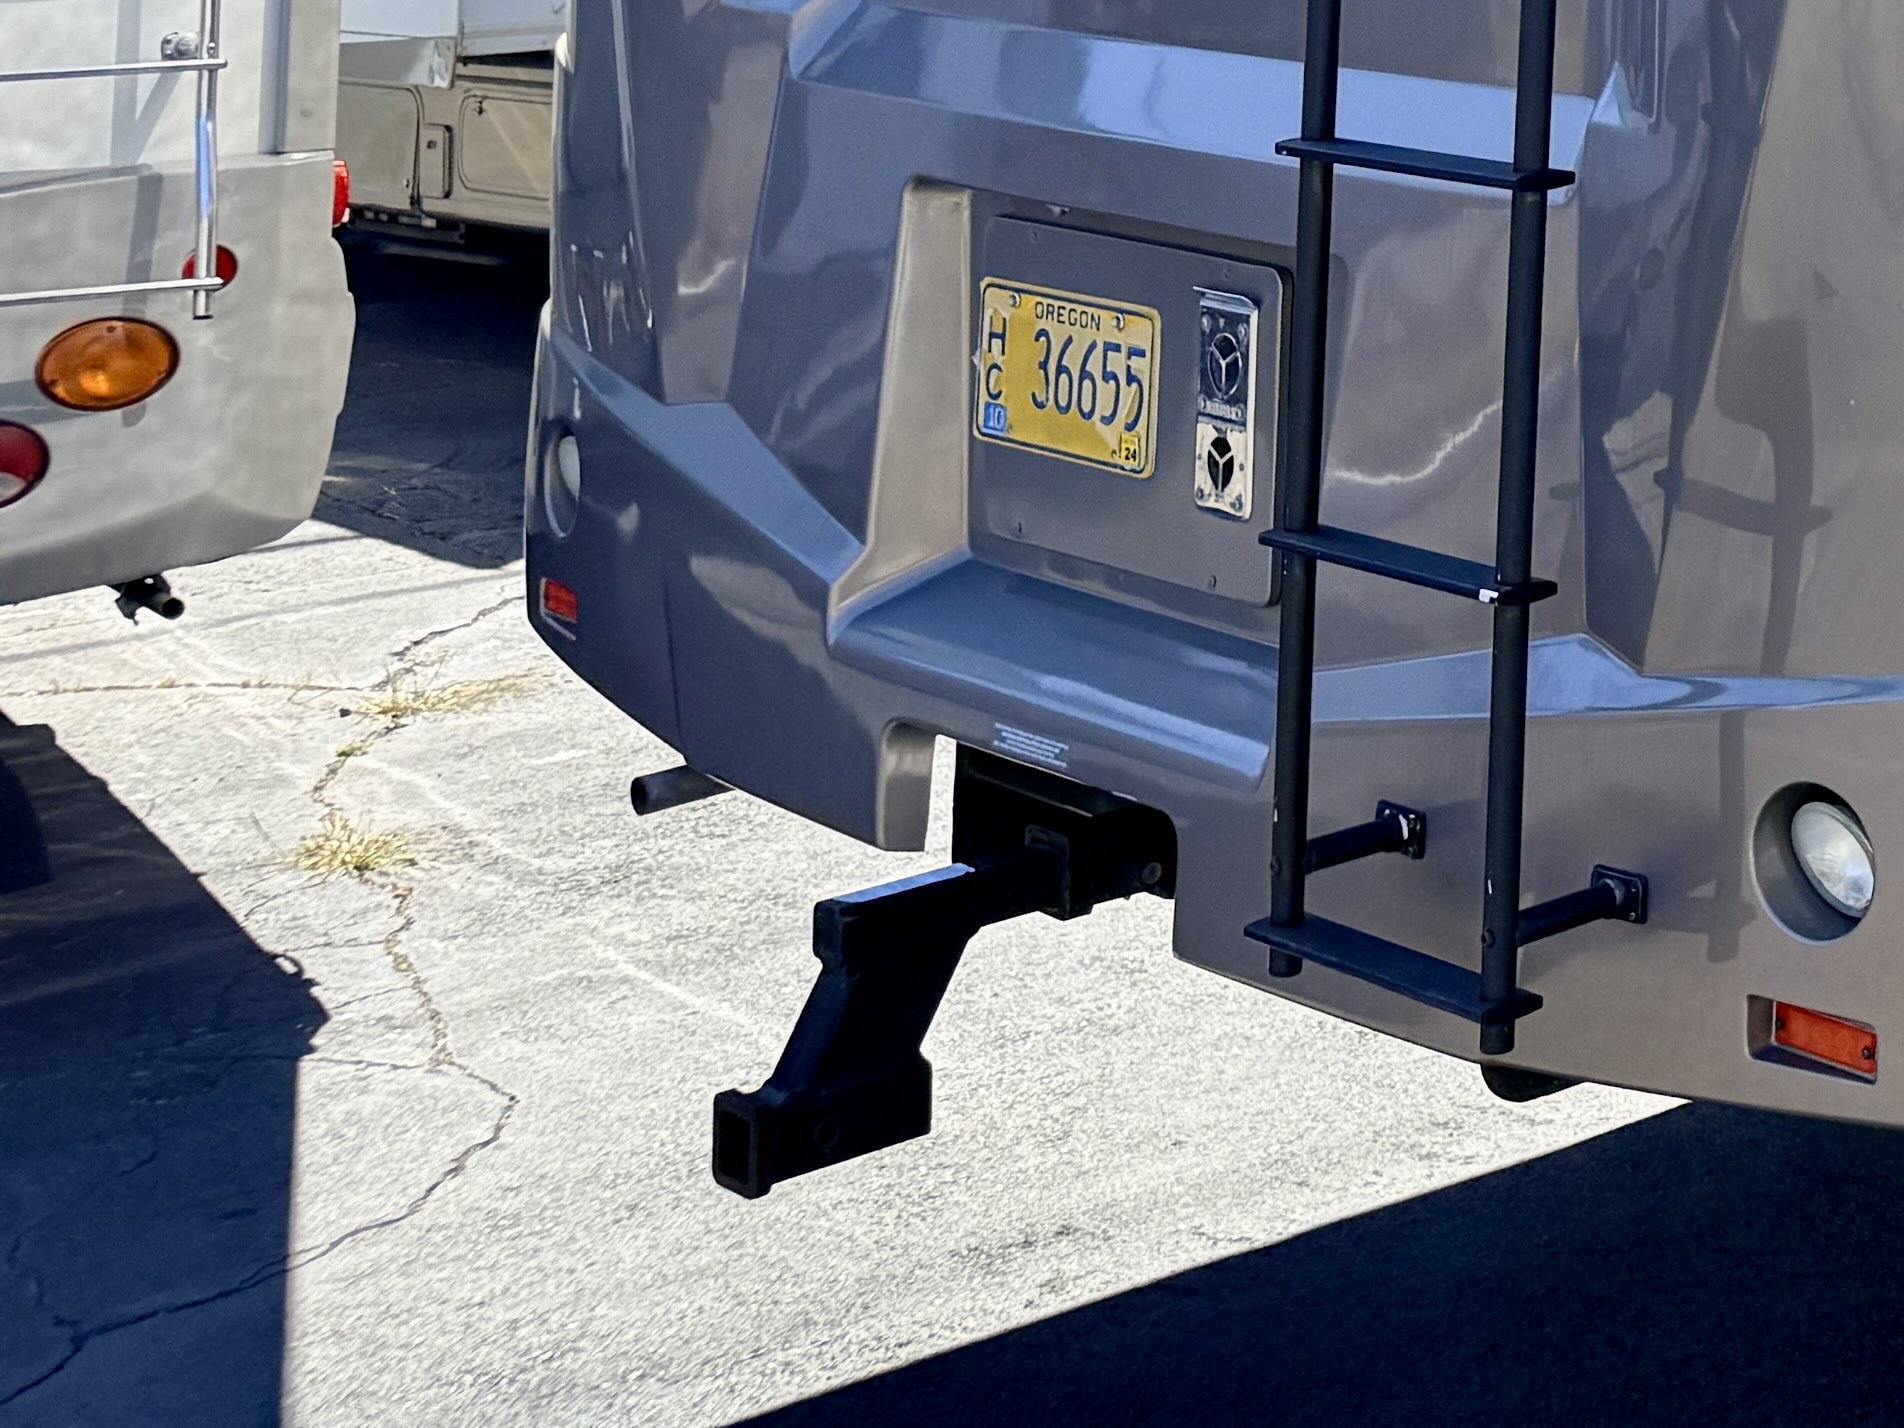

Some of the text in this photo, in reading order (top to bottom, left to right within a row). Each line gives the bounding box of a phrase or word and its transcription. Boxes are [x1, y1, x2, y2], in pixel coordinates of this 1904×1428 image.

[1034, 301, 1100, 332] OREGON
[1031, 328, 1147, 433] 36655
[1124, 446, 1137, 462] 24
